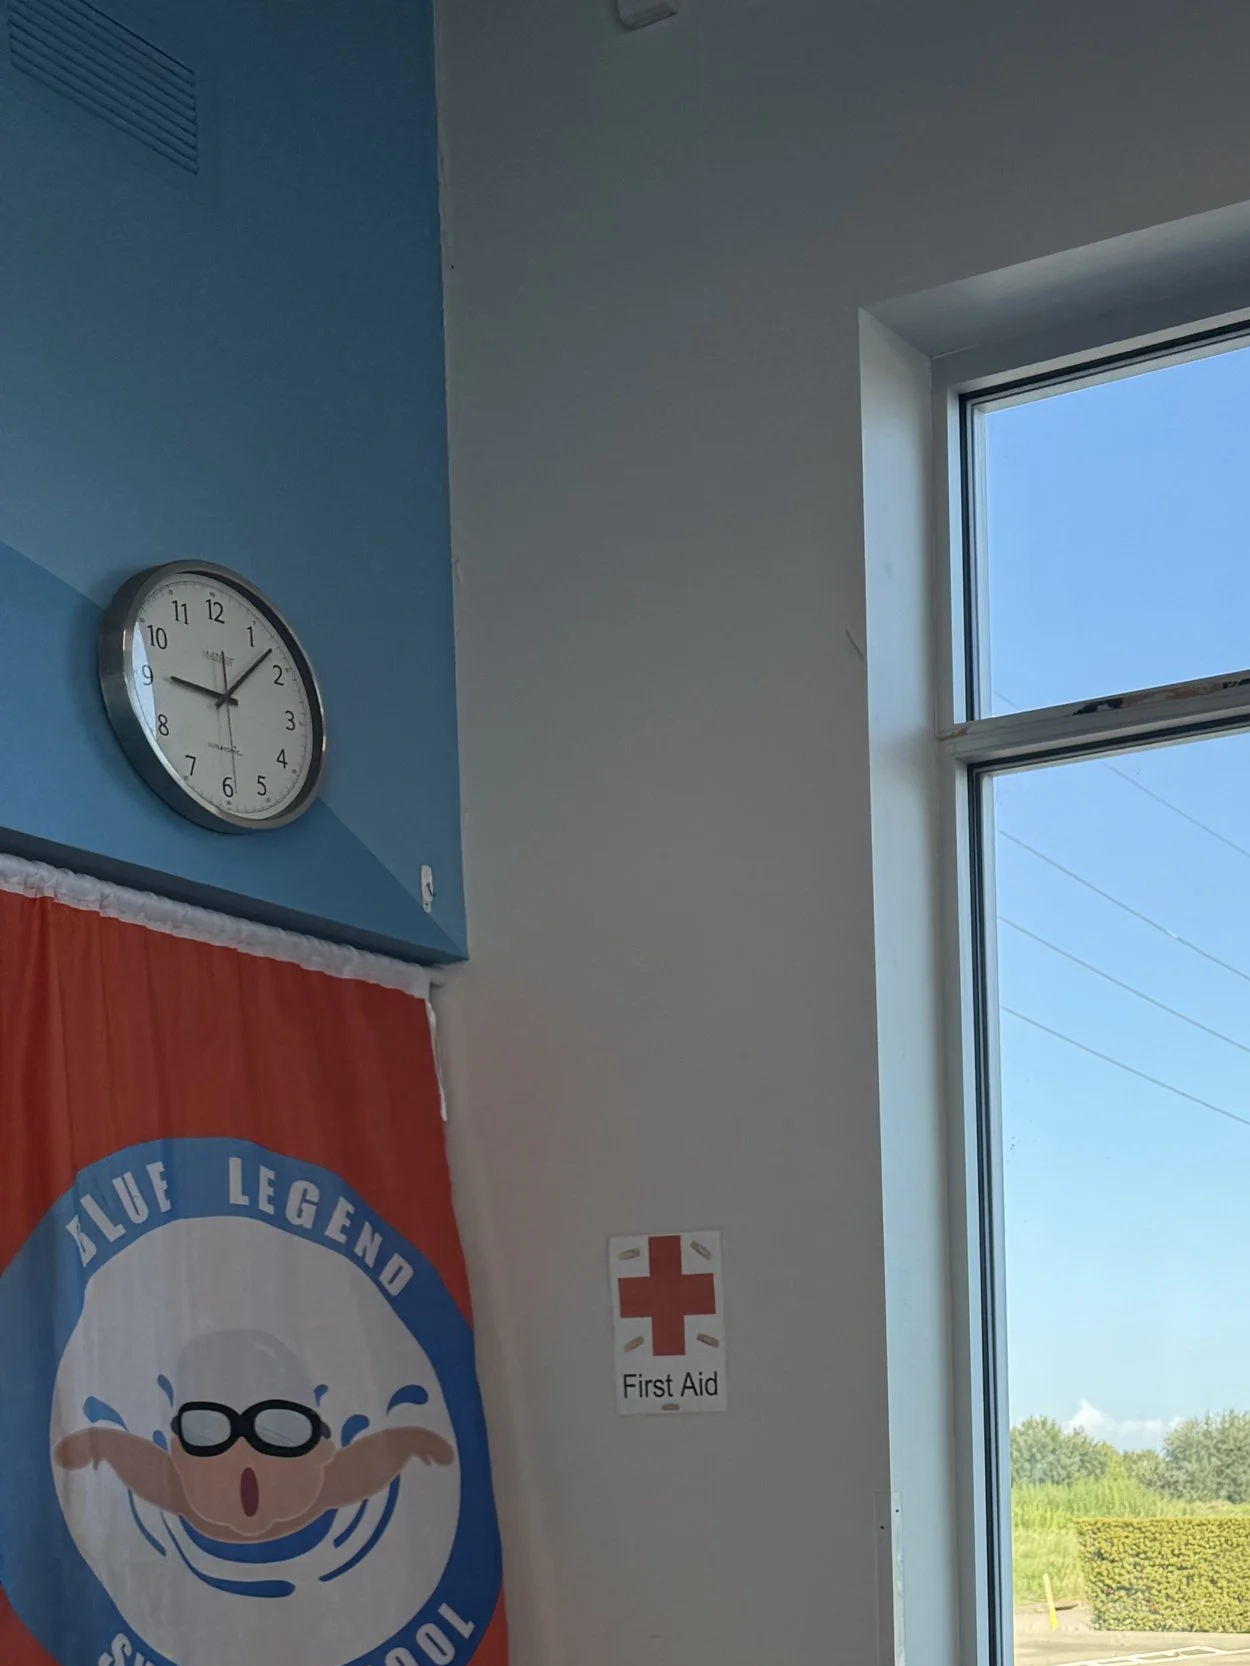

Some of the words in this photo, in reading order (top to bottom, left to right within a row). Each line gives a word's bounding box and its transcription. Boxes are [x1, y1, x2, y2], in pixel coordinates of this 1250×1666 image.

[172, 600, 189, 625] 11
[206, 598, 225, 624] 12
[147, 624, 168, 650] 10
[247, 626, 254, 647] 1
[141, 664, 154, 686] 9
[272, 664, 284, 686] 2
[158, 714, 169, 736] 8
[285, 710, 296, 731] 3
[185, 754, 196, 776] 7
[276, 748, 288, 769] 4
[222, 777, 234, 798] 6
[257, 775, 267, 796] 5
[228, 1156, 414, 1297] LEGEND
[623, 1373, 673, 1398] First
[680, 1371, 718, 1397] Aid
